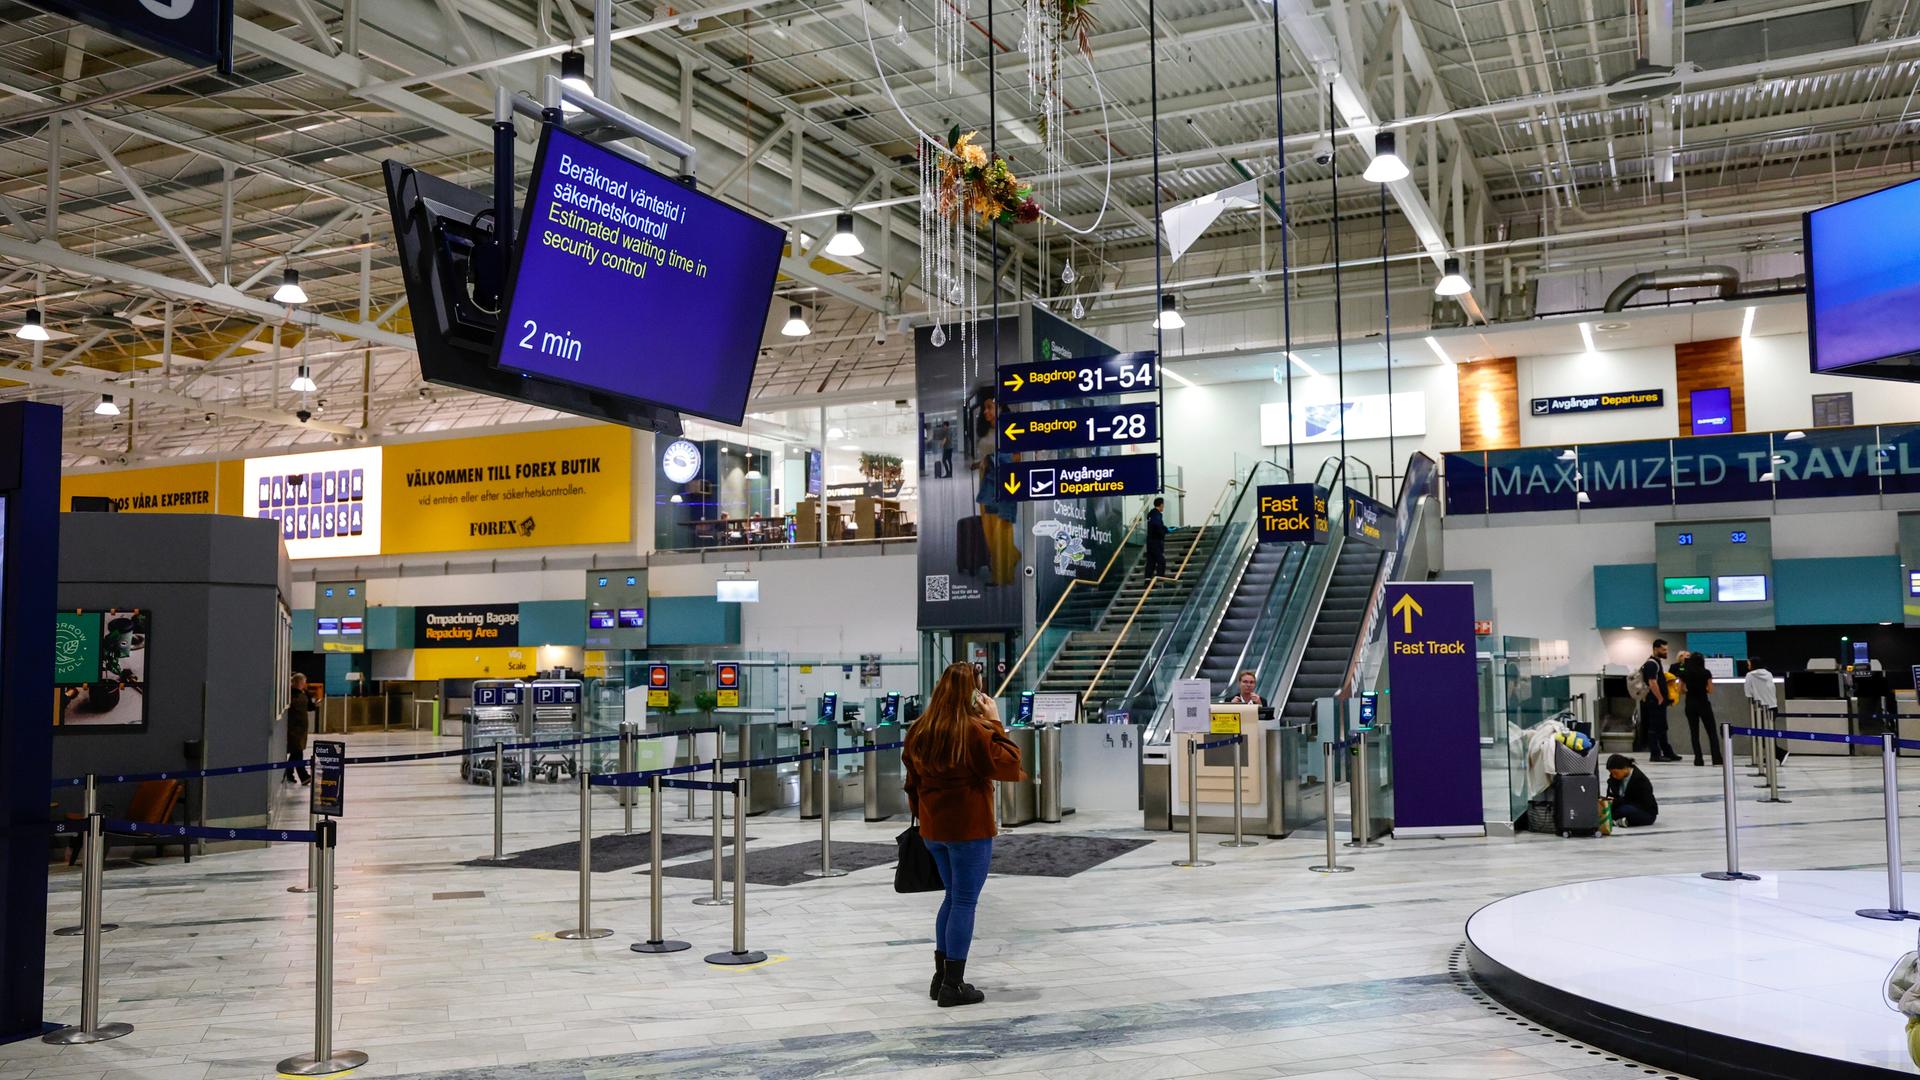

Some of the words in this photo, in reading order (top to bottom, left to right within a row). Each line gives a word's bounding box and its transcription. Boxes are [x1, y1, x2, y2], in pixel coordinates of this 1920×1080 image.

[559, 153, 628, 199] Beräknad
[630, 188, 680, 224] väntetid
[680, 207, 687, 225] i
[553, 182, 669, 241] säkerhetskontroll
[548, 202, 620, 245] Estimated
[622, 233, 666, 267] waiting
[668, 249, 694, 273] time
[695, 259, 707, 278] in
[542, 230, 600, 266] security
[601, 251, 648, 279] control
[519, 319, 538, 350] 2
[541, 331, 583, 363] min
[1029, 370, 1077, 384] Bagdrop
[1078, 363, 1153, 392] 31-54
[1551, 397, 1599, 410] Avgångar
[1601, 393, 1659, 406] Departures
[1029, 419, 1077, 434] Bagdrop
[1086, 413, 1146, 441] 1-28
[406, 468, 483, 487] VÄLKOMMEN
[488, 465, 511, 481] TILL
[515, 461, 556, 479] FOREX
[561, 457, 601, 475] BUTIK
[1060, 466, 1115, 482] Avgångar
[1491, 453, 1727, 497] MAXIMIZED
[1060, 481, 1124, 494] Departures
[132, 492, 158, 509] VÅRA
[161, 490, 209, 507] EXPERTER
[418, 495, 431, 506] vid
[461, 491, 479, 503] eller
[480, 490, 499, 502] efter
[1261, 495, 1299, 513] Fast
[469, 520, 518, 536] FOREX
[1262, 513, 1310, 532] Track
[1090, 526, 1112, 545] Airport
[1679, 534, 1693, 545] 31
[1731, 532, 1747, 542] 32
[426, 613, 484, 627] Ompackning
[426, 627, 473, 640] Repacking
[475, 627, 498, 638] Area
[1393, 641, 1425, 655] Fast
[1426, 640, 1466, 654] Track
[508, 662, 527, 671] Scale
[483, 691, 493, 702] P
[542, 689, 551, 701] P
